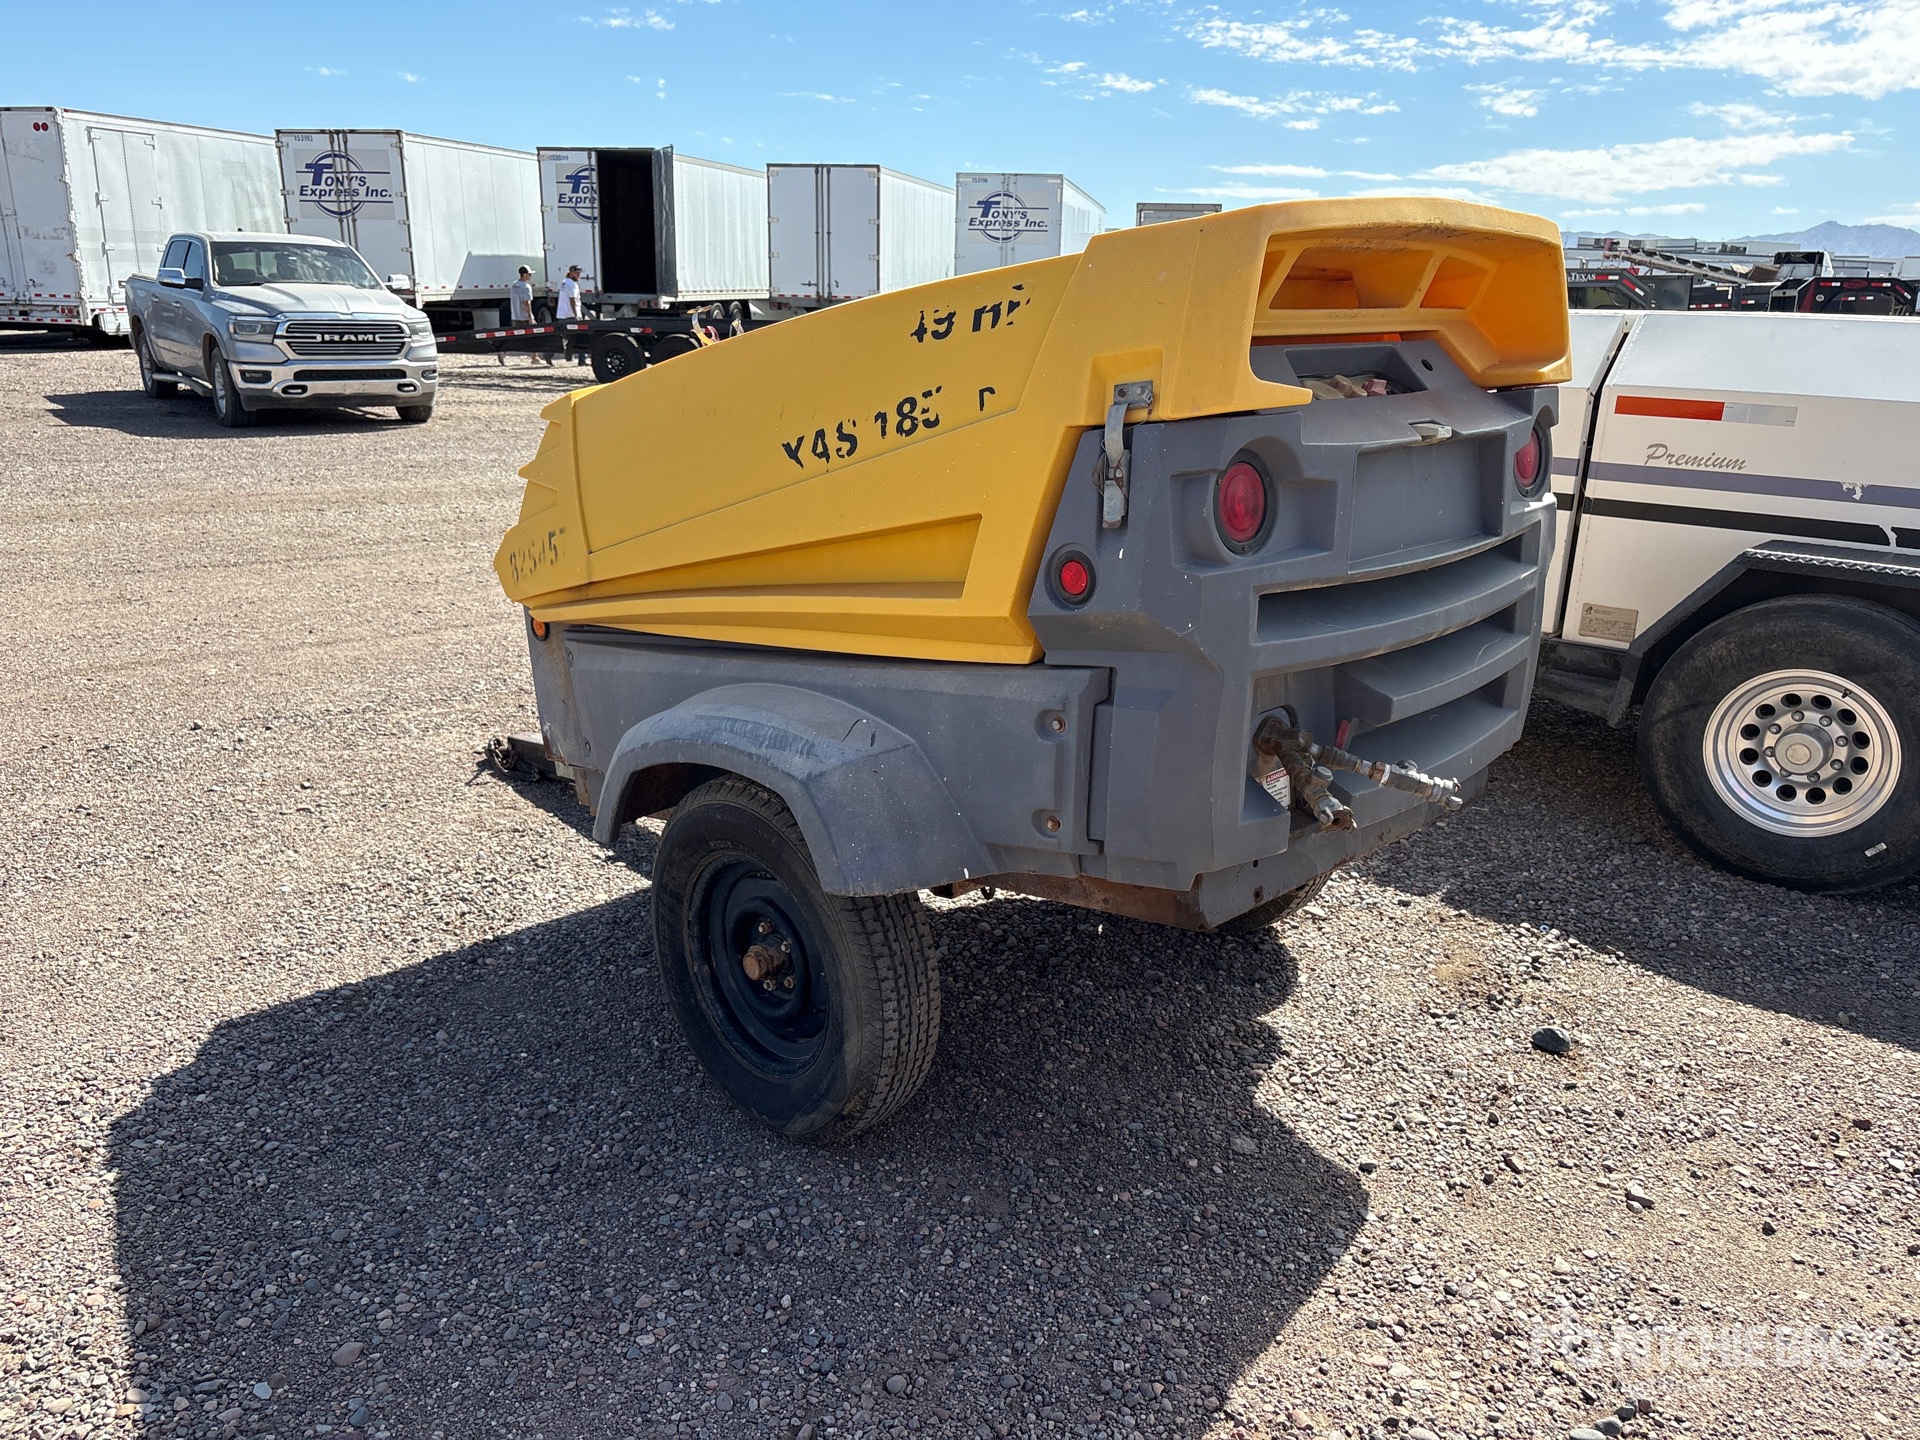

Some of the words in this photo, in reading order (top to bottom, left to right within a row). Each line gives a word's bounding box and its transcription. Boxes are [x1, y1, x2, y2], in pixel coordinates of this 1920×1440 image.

[293, 134, 314, 142] 153193
[299, 185, 360, 199] Express
[365, 186, 392, 198] Inc.
[968, 217, 1021, 228] Express
[1024, 218, 1048, 228] Inc.
[323, 333, 374, 342] RAM
[1643, 443, 1747, 470] Premium
